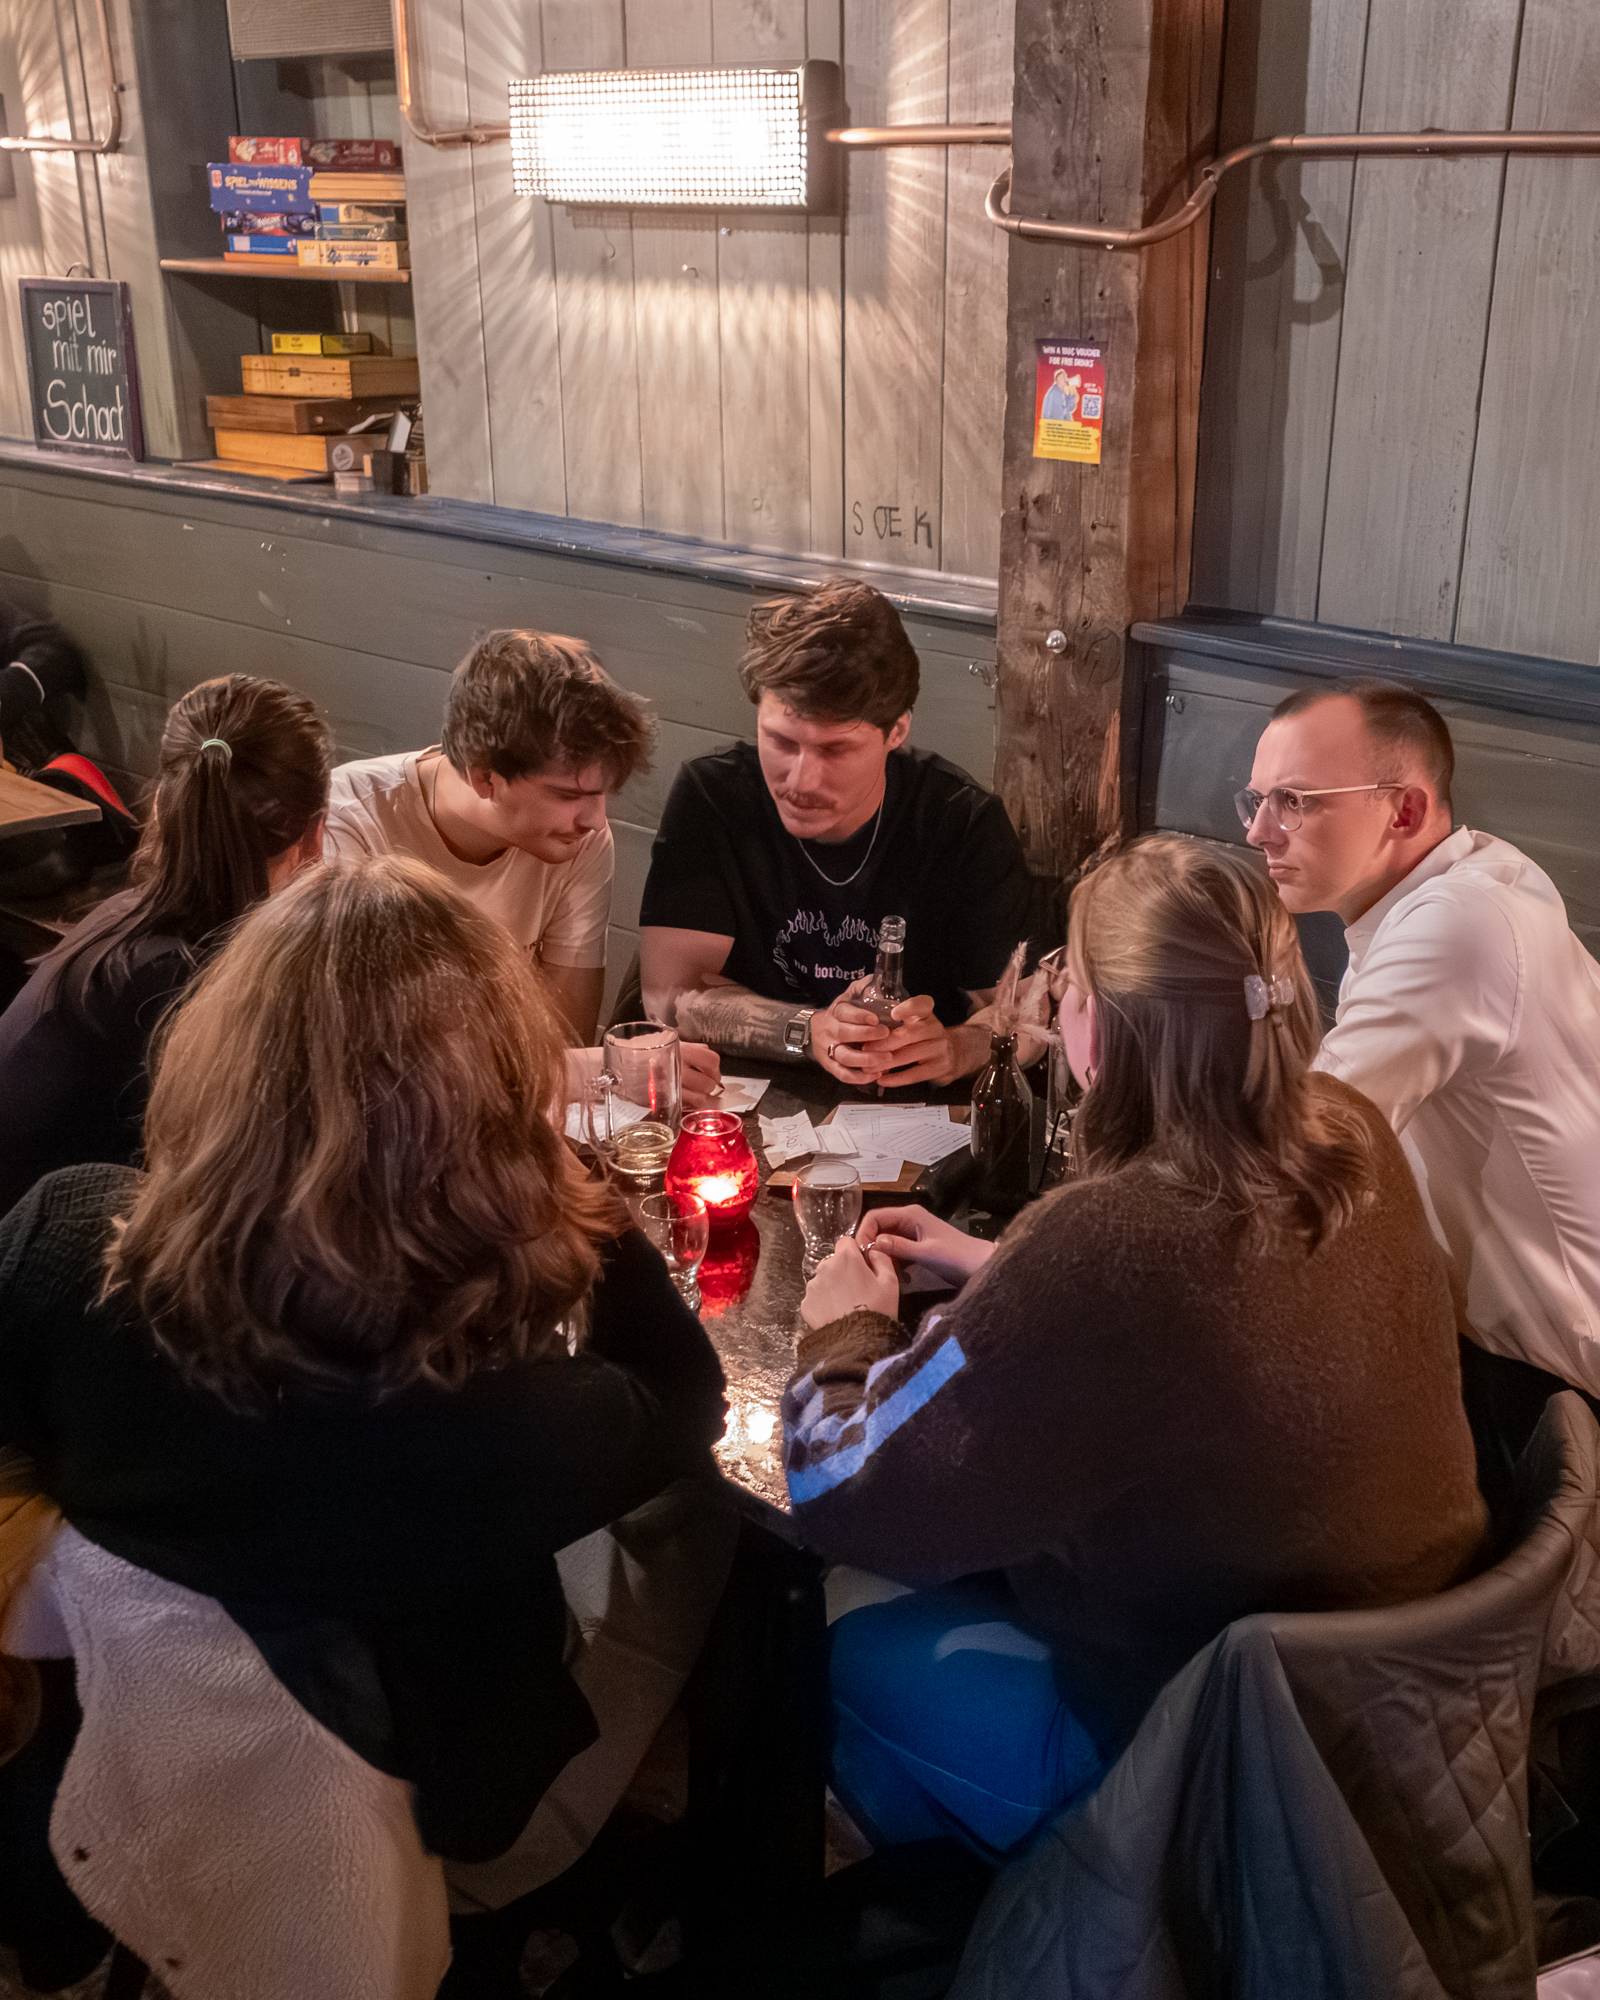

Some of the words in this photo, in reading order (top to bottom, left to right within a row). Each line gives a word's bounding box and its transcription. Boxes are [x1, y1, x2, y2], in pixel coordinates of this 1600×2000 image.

[42, 294, 96, 338] spiel
[52, 331, 82, 372] mit
[87, 339, 116, 375] mir
[1042, 346, 1056, 355] WIN
[1076, 348, 1101, 357] VOUCHER
[1049, 356, 1060, 365] FOR
[1061, 357, 1073, 366] FREE
[1074, 358, 1094, 368] DRINKS
[814, 963, 866, 980] borders
